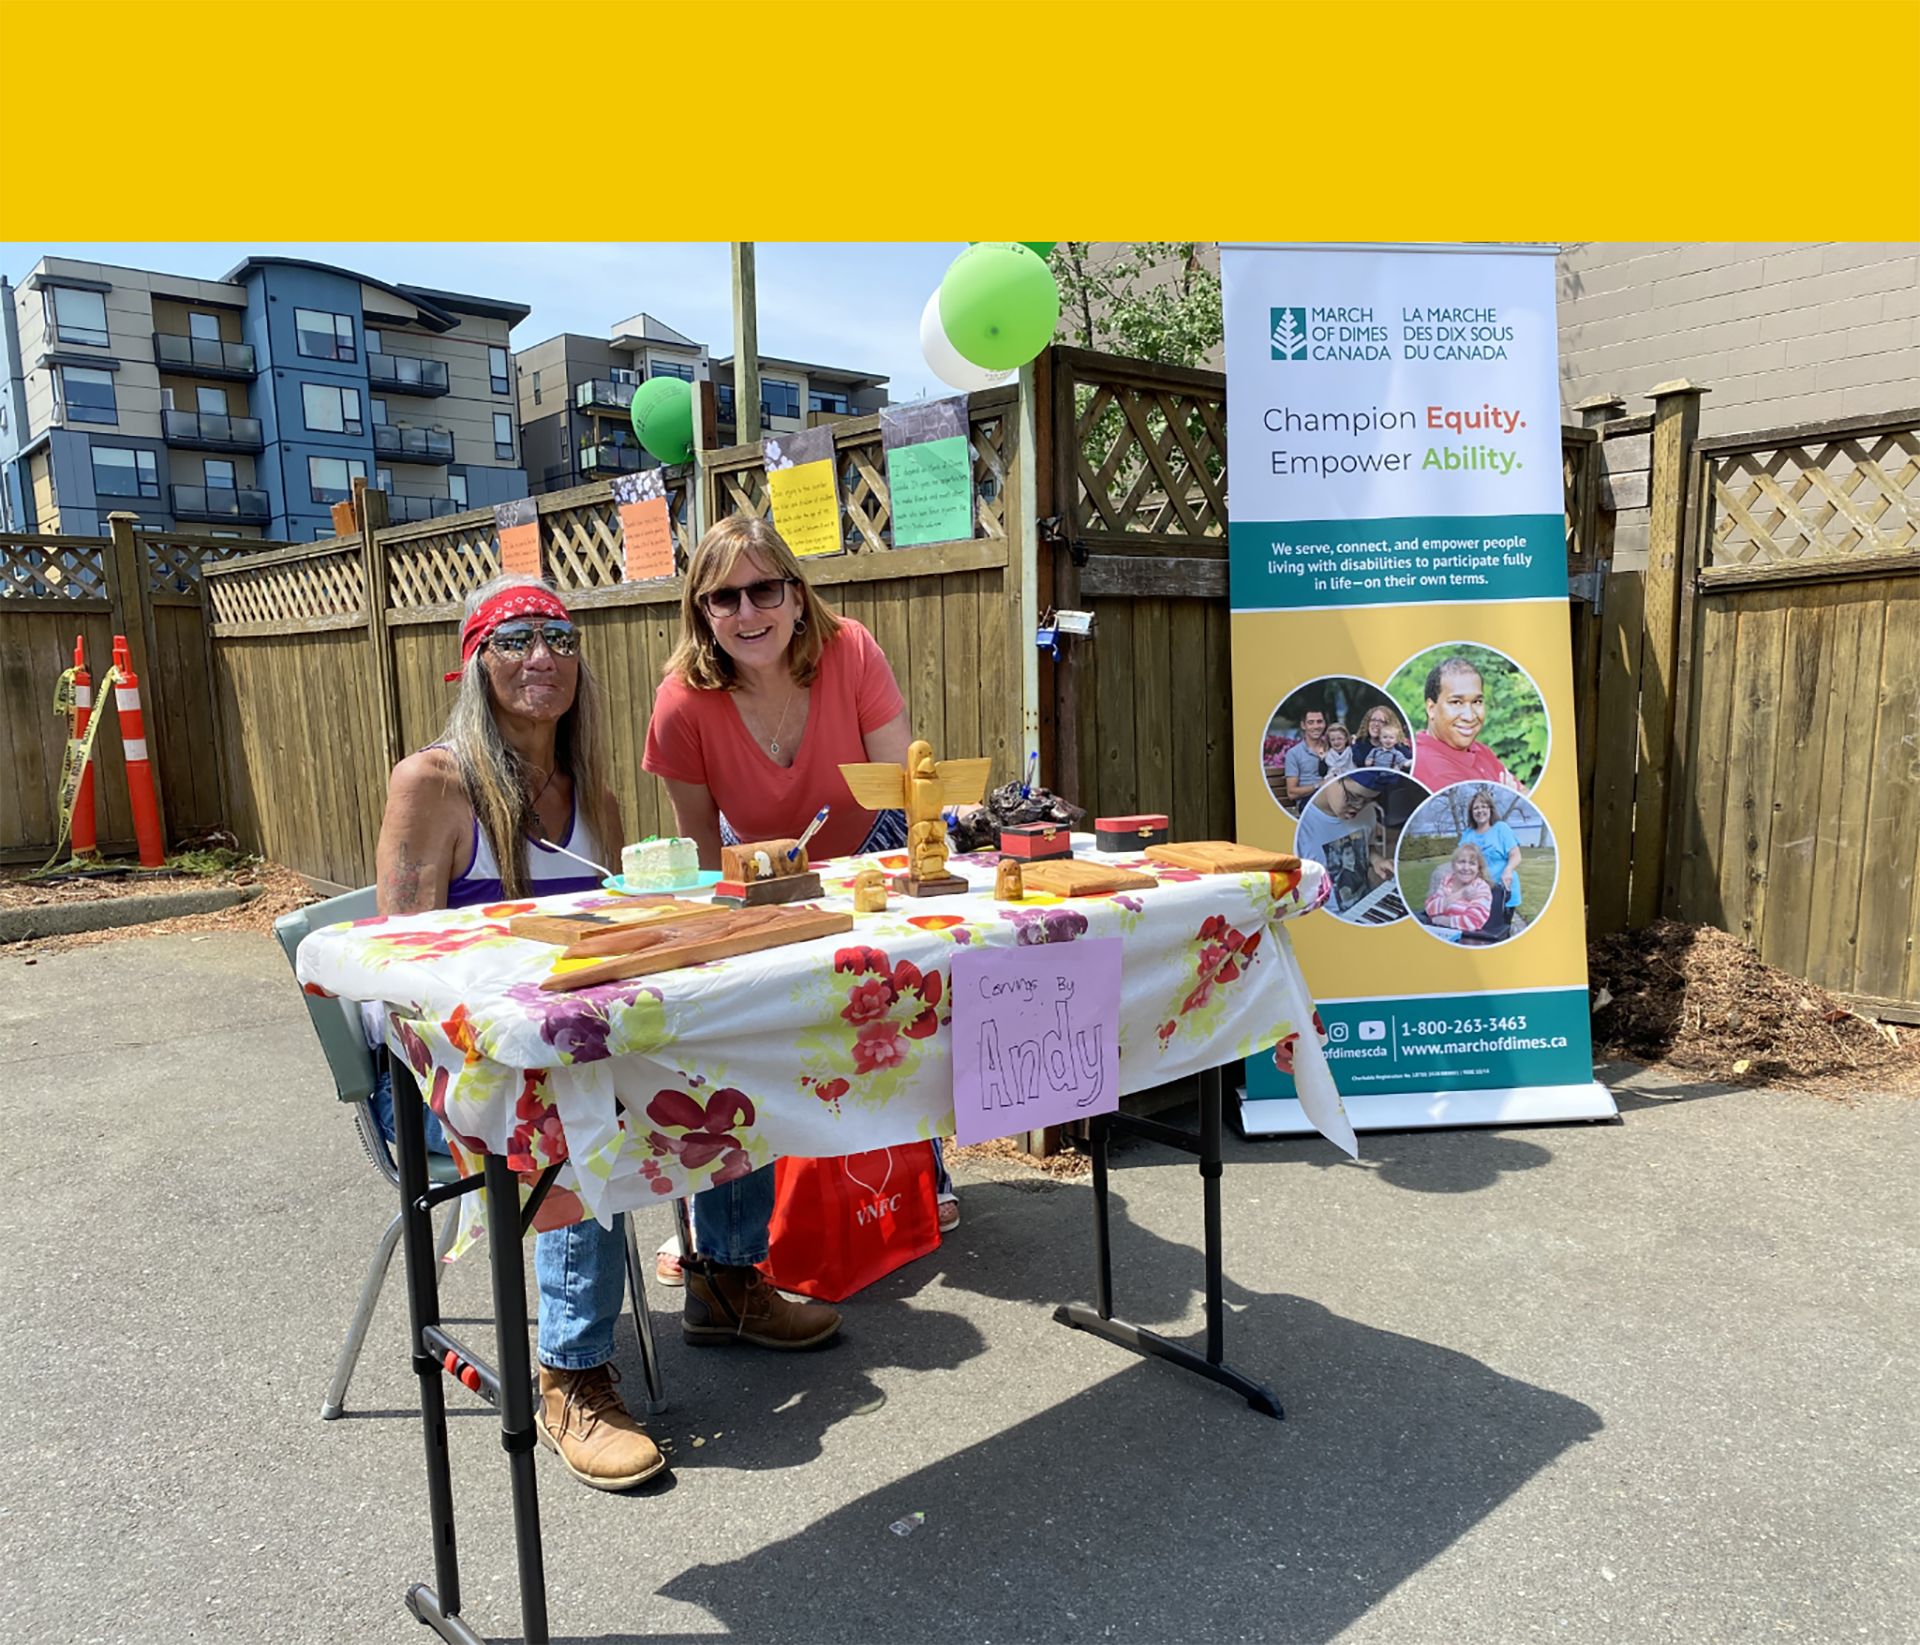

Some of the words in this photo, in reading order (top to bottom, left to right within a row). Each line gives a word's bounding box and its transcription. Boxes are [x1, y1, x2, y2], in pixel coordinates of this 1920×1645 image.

[1312, 308, 1373, 322] MARCH
[1403, 308, 1422, 322] LA
[1427, 308, 1496, 322] MARCHE
[1312, 327, 1336, 341] OF
[1340, 327, 1387, 341] DIMES
[1404, 327, 1433, 341] DES
[1437, 327, 1465, 341] DIX
[1471, 327, 1513, 341] SOUS
[1313, 346, 1391, 360] CANADA
[1405, 346, 1429, 360] DU
[1434, 346, 1507, 360] CANADA
[1264, 407, 1416, 436] Champion
[1427, 404, 1526, 434] Equity.
[1272, 451, 1412, 477] Empower
[1422, 446, 1523, 475] Ability.
[1272, 543, 1292, 555] We
[1295, 543, 1333, 556] serve,
[1336, 539, 1391, 554] connect,
[1394, 538, 1418, 550] and
[1422, 538, 1479, 552] empower
[1483, 536, 1526, 551] people
[1268, 561, 1304, 575] living
[1308, 560, 1336, 572] with
[1340, 557, 1411, 571] disabilities
[1416, 557, 1429, 568] to
[1433, 554, 1499, 569] participate
[1503, 553, 1532, 568] fully
[1315, 578, 1327, 590] in
[1385, 574, 1415, 587] their
[1420, 575, 1446, 585] own
[1450, 572, 1488, 585] terms.
[1057, 976, 1074, 1001] By
[1402, 1016, 1527, 1036] 1-800-263-3463
[980, 1001, 1104, 1110] Andy
[1402, 1034, 1567, 1057] www.marchofdimes.ca
[856, 1193, 902, 1226] VNFC
